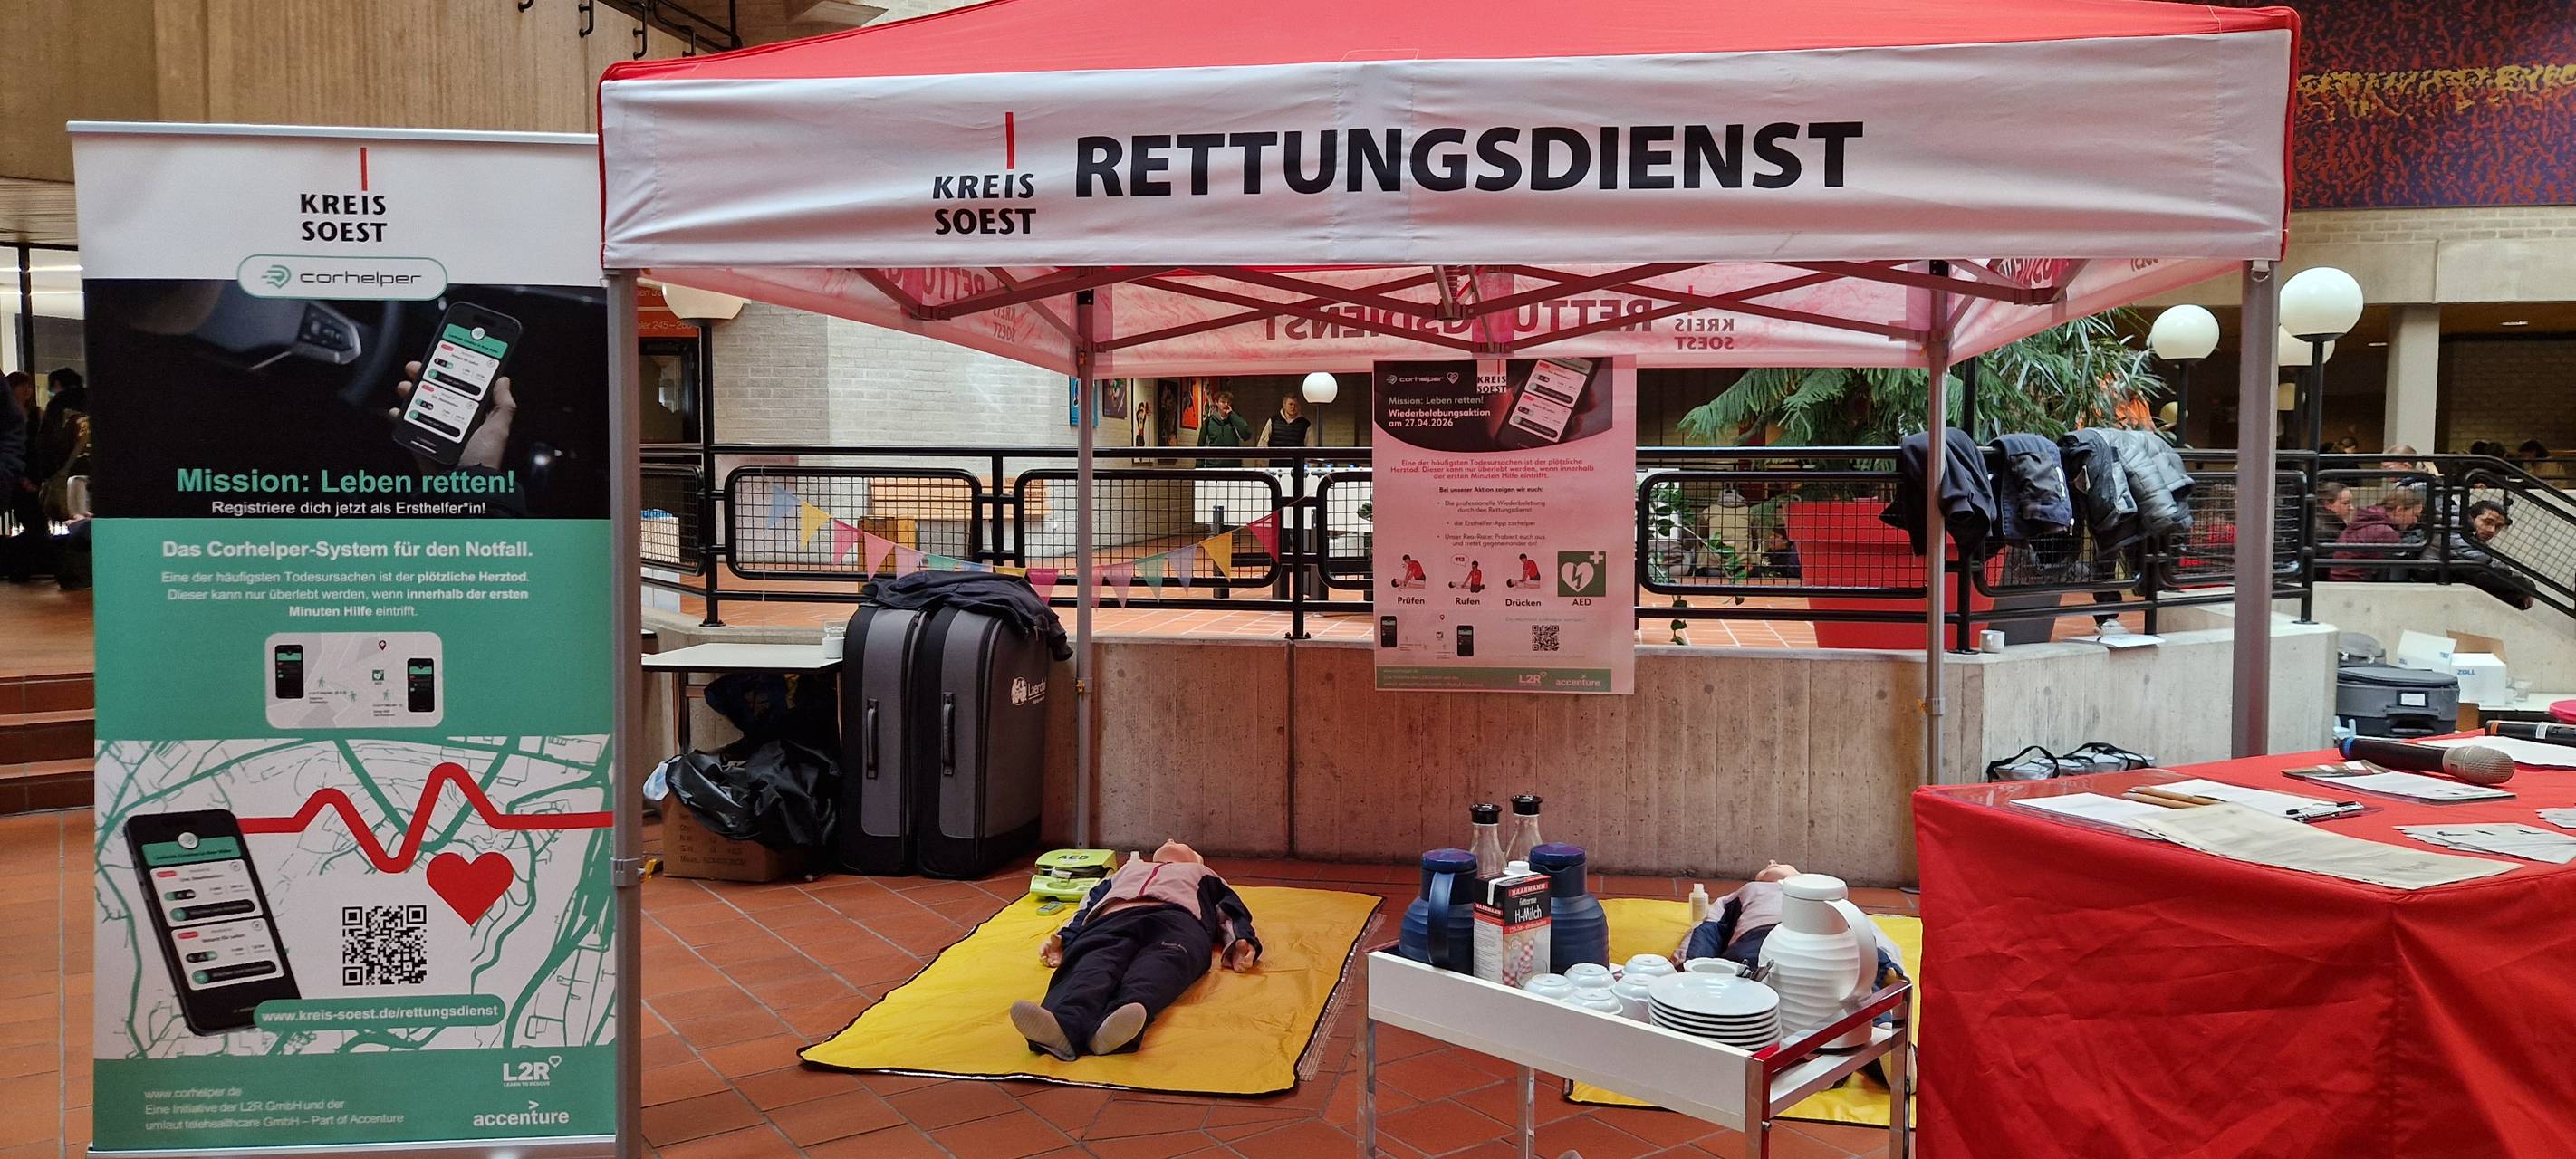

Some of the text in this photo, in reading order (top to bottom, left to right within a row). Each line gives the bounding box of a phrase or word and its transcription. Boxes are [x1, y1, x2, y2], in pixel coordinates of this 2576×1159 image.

[1075, 121, 1863, 197] RETTUNGSDIENST
[934, 173, 1035, 200] KREIS
[300, 193, 387, 216] KREIS
[934, 207, 1036, 235] SOEST
[301, 222, 387, 242] SOEST
[300, 269, 421, 287] corhelper
[1389, 397, 1423, 405] Mission:
[1455, 396, 1484, 404] retten!
[1389, 408, 1491, 418] Wiederbelebungsaktion
[1405, 418, 1453, 426] 27.04.2026
[178, 468, 515, 493] Mission: Leben retten!
[211, 501, 296, 516] Registriere
[300, 501, 332, 514] dich
[334, 501, 367, 516] jetzt
[370, 501, 391, 514] als
[163, 541, 533, 560] Das Corhelper-System für den Notfall.
[161, 570, 529, 585] Eine der häufigsten Todesursachen ist der plötzliche Herztod.
[168, 588, 528, 601] Dieser kann nur überlebt werden, wenn innerhalb der ersten
[1398, 597, 1480, 605] Prüfen Rufen
[289, 605, 418, 617] Minuten Hilfe eintrifft.
[1505, 599, 1542, 607] Drücken
[1519, 675, 1541, 684] L2R
[1515, 905, 1542, 923] H-Milch
[261, 1002, 499, 1022] www.kreis-soest.de/rettungsdienst
[503, 1062, 550, 1081] L2R
[145, 1087, 242, 1099] www.corhelper.de
[145, 1104, 169, 1115] Eine
[220, 1103, 237, 1113] der
[240, 1102, 262, 1112] L2R
[265, 1100, 302, 1111] GmbH
[303, 1100, 324, 1111] und
[327, 1099, 344, 1110] der
[145, 1120, 183, 1131] umlaut
[263, 1116, 300, 1128] GmbH
[312, 1115, 334, 1126] Part
[336, 1115, 348, 1125] of
[350, 1113, 405, 1125] Accenture
[473, 1110, 570, 1126] accenture
